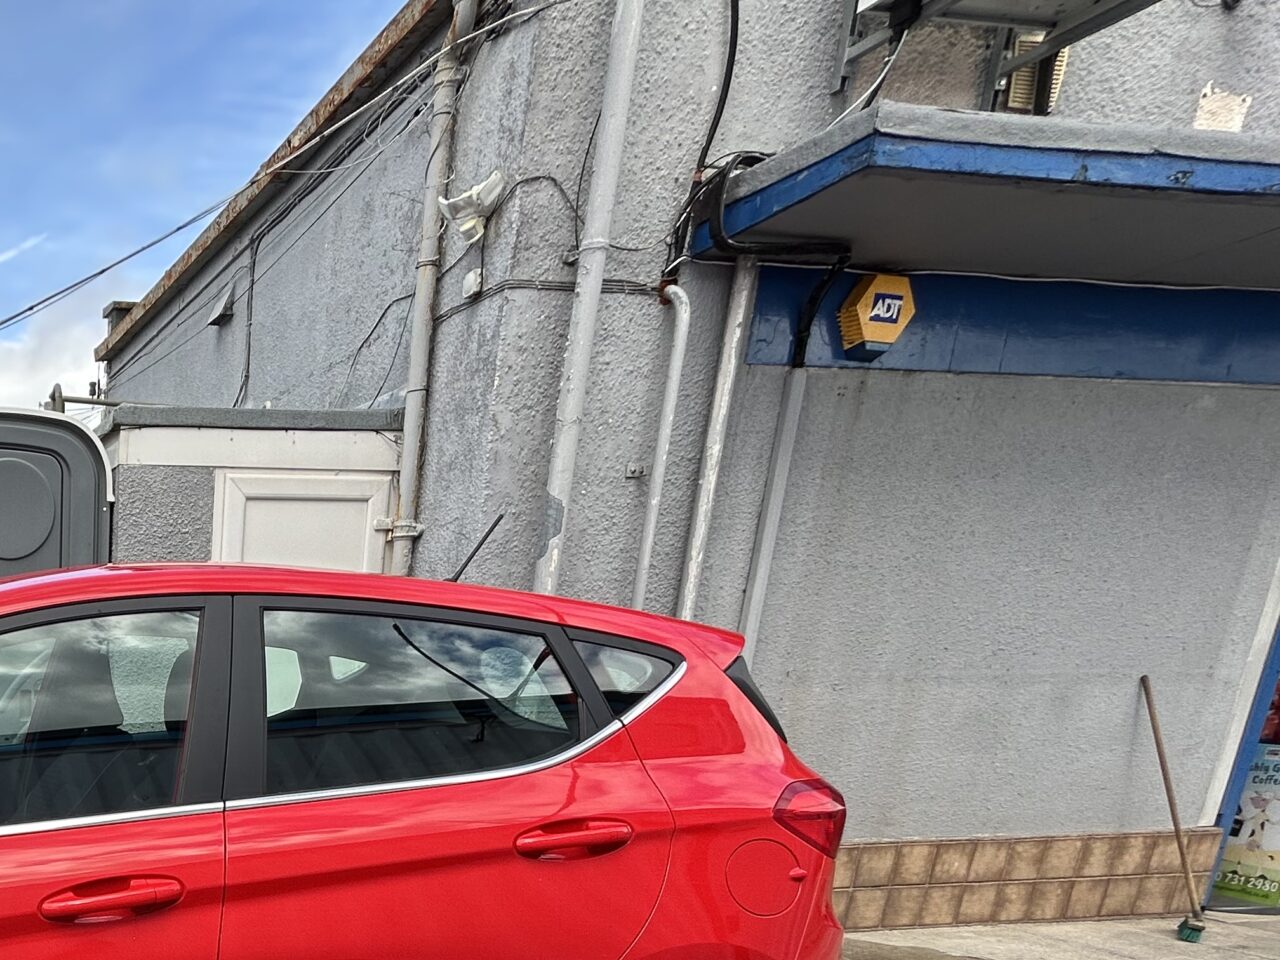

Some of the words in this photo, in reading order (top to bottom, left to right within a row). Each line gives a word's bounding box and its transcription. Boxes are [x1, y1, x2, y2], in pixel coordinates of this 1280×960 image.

[870, 298, 903, 319] ADT
[1251, 774, 1280, 785] Coffe
[1224, 873, 1246, 885] 731
[1247, 877, 1279, 892] 2980
